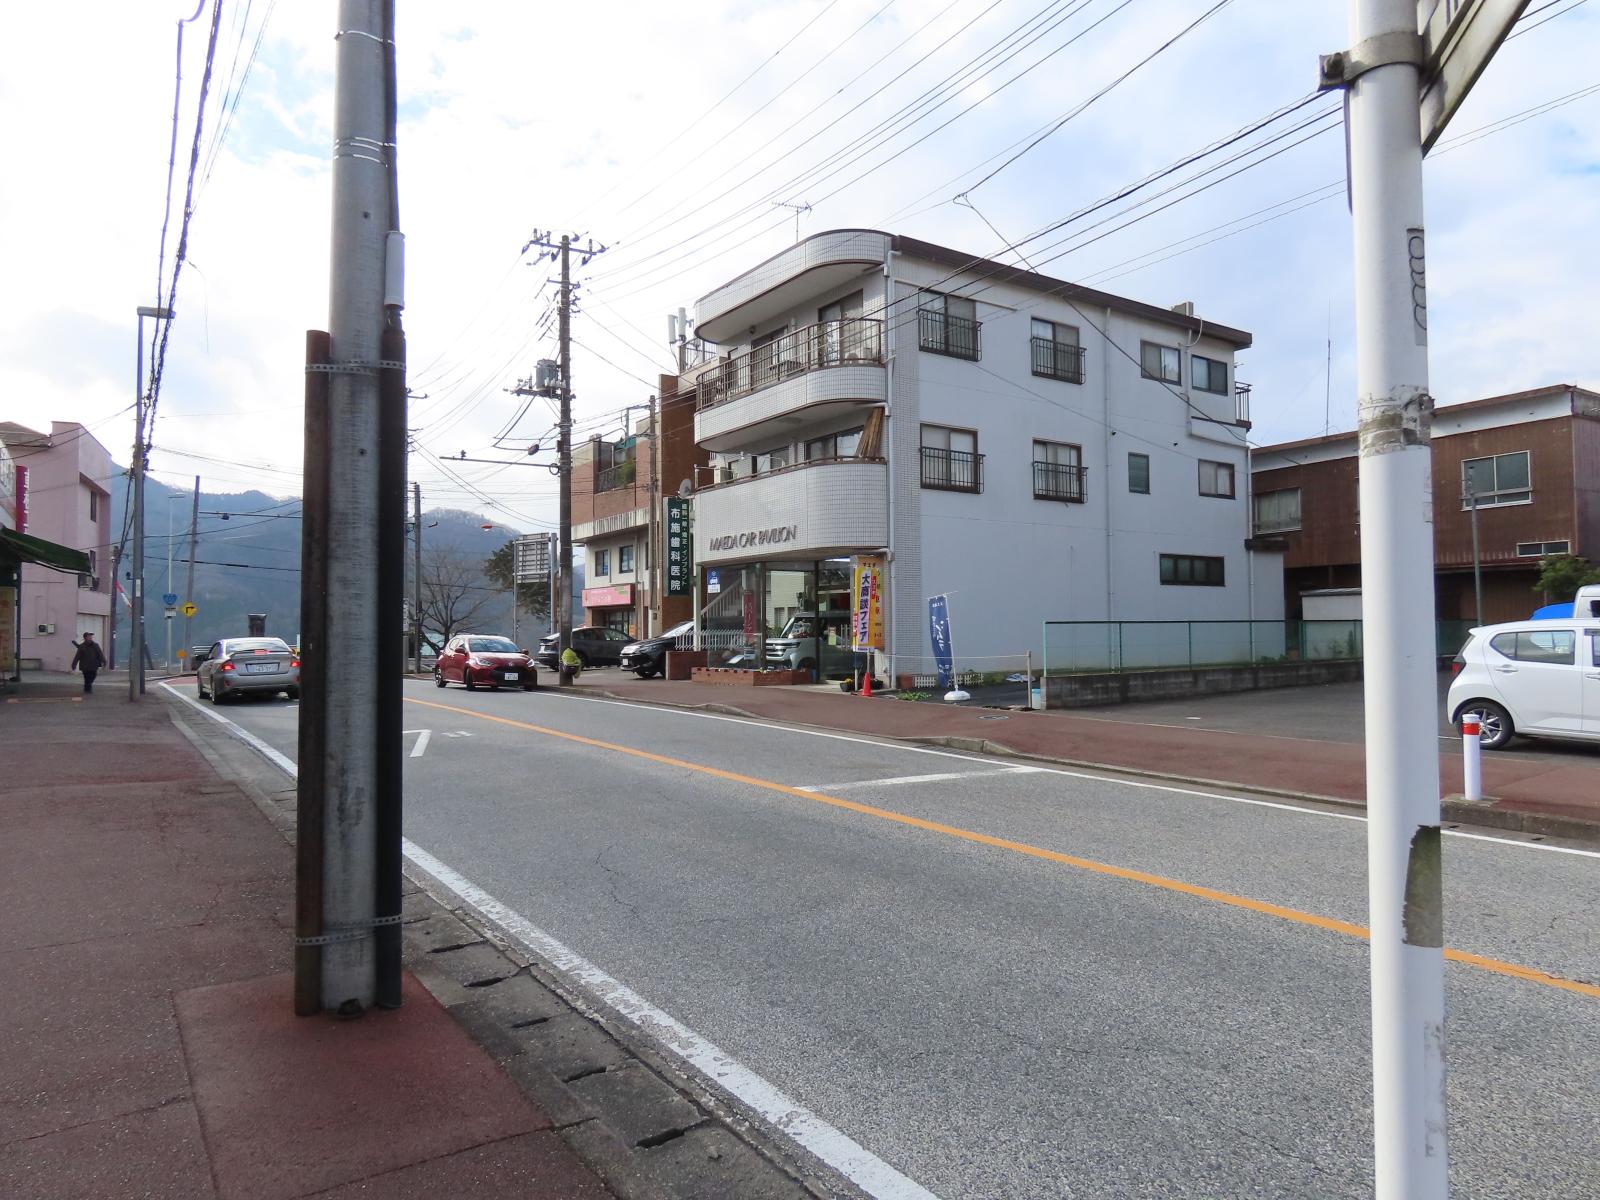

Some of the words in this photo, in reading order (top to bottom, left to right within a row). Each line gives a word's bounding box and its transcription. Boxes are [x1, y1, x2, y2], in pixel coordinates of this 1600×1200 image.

[670, 508, 681, 591] 布施歯科医院
[710, 535, 738, 551] MAEDA
[739, 531, 757, 548] CAR
[758, 525, 797, 545] PAVILION
[859, 573, 871, 642] 大商談フェア
